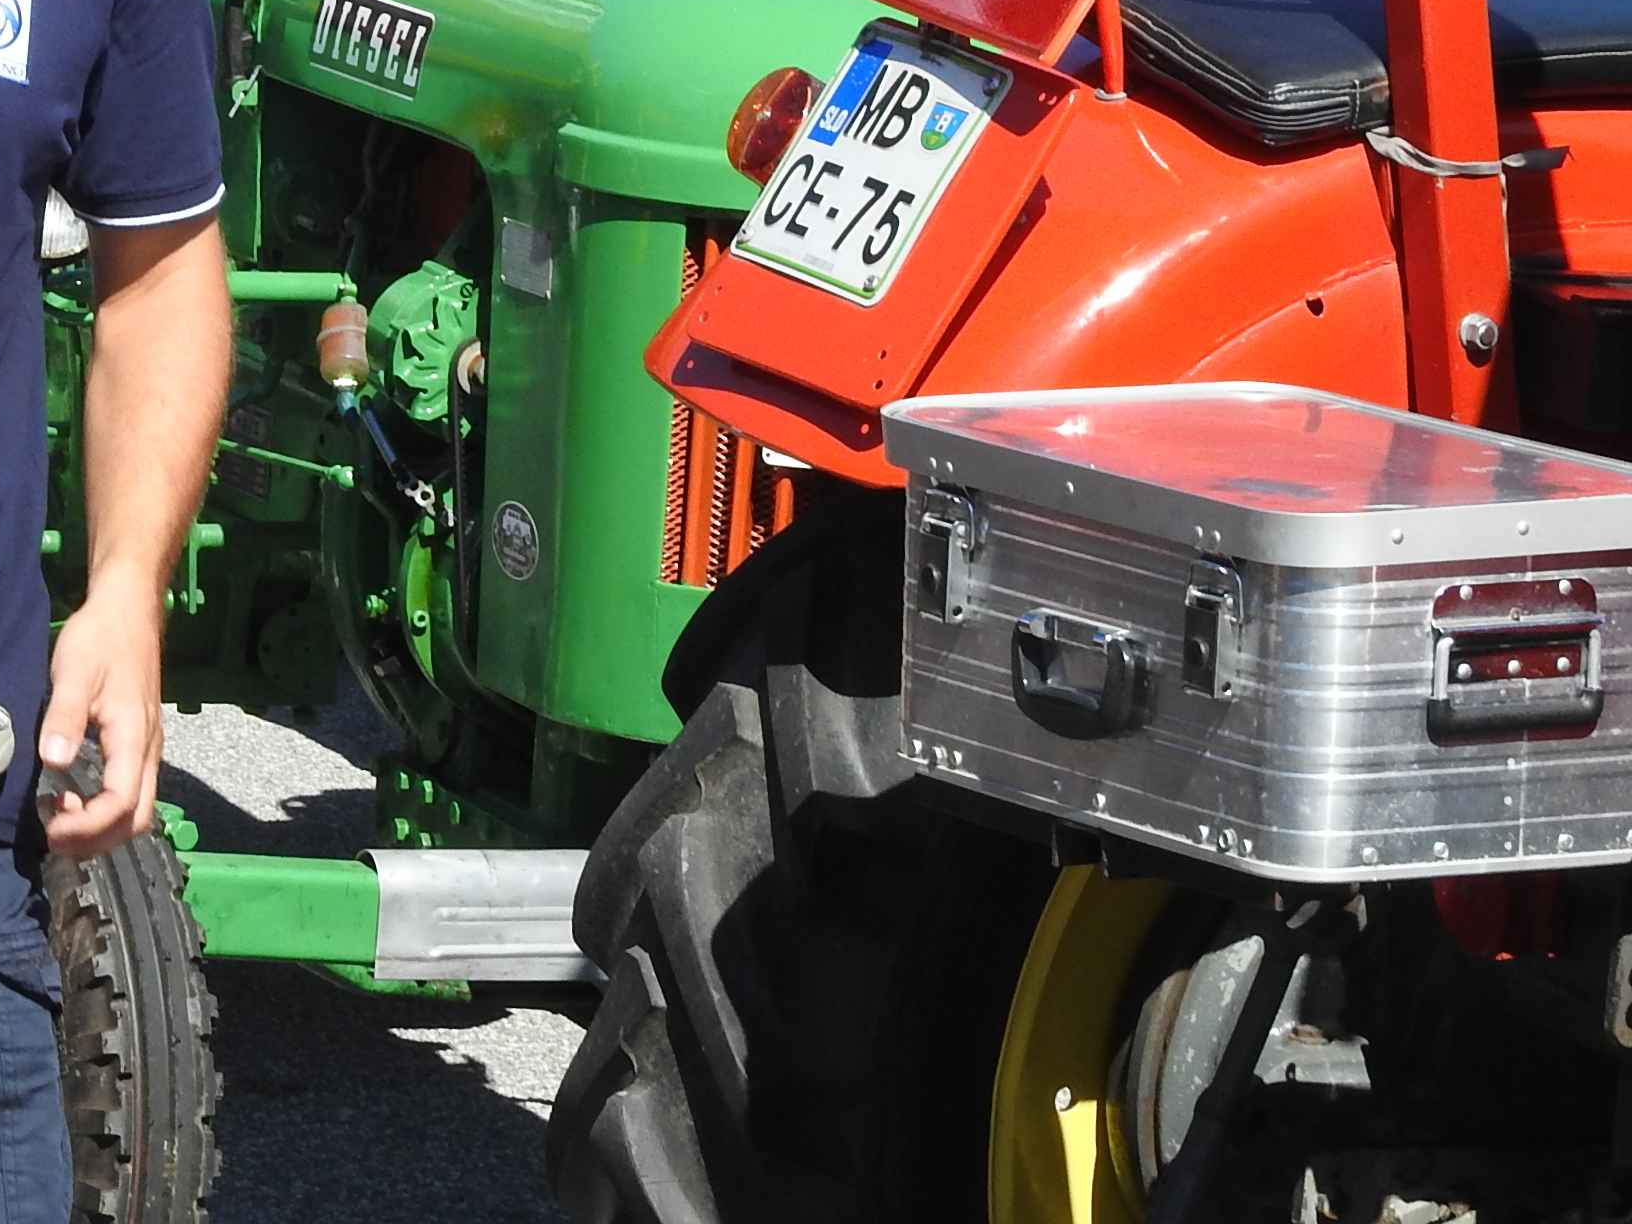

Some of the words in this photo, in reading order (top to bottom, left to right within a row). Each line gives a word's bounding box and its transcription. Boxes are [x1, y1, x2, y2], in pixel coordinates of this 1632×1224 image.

[819, 105, 849, 133] SLO
[843, 64, 930, 149] MB
[763, 154, 916, 266] CE-75
